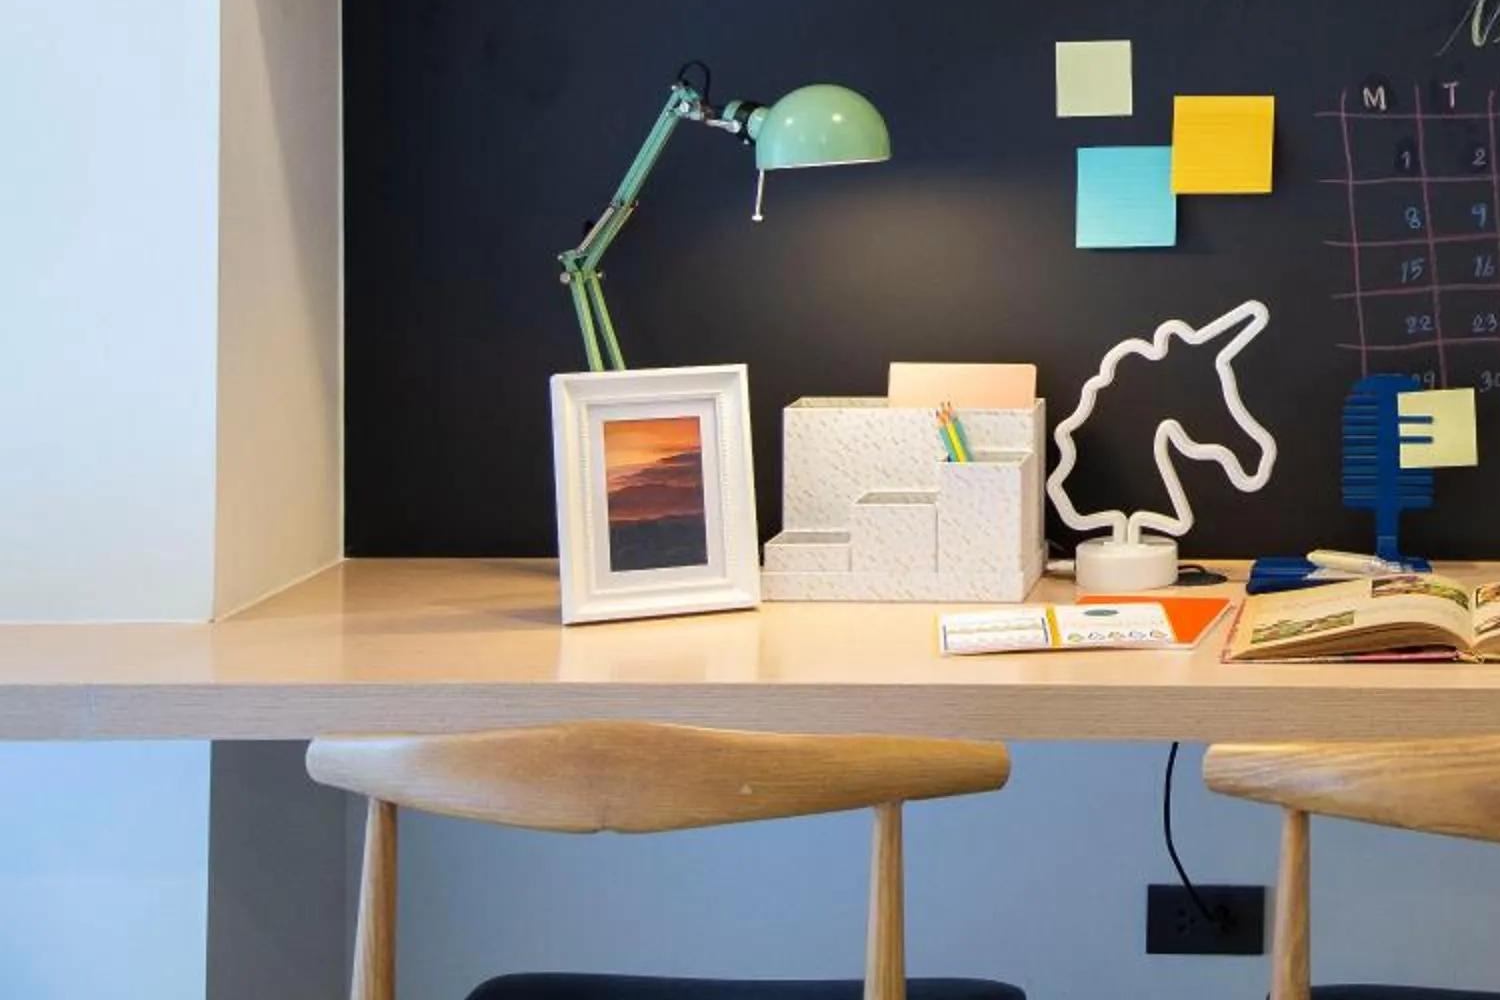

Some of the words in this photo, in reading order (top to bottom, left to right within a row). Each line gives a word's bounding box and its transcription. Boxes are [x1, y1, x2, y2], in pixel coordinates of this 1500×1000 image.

[1363, 85, 1388, 111] M
[1443, 81, 1460, 108] T
[1401, 151, 1410, 168] 1
[1472, 149, 1486, 165] 2
[1405, 207, 1421, 228] 8
[1471, 203, 1487, 227] 9
[1400, 257, 1425, 283] 15
[1473, 256, 1494, 277] 16
[1406, 315, 1434, 332] 22
[1472, 313, 1498, 333] 23
